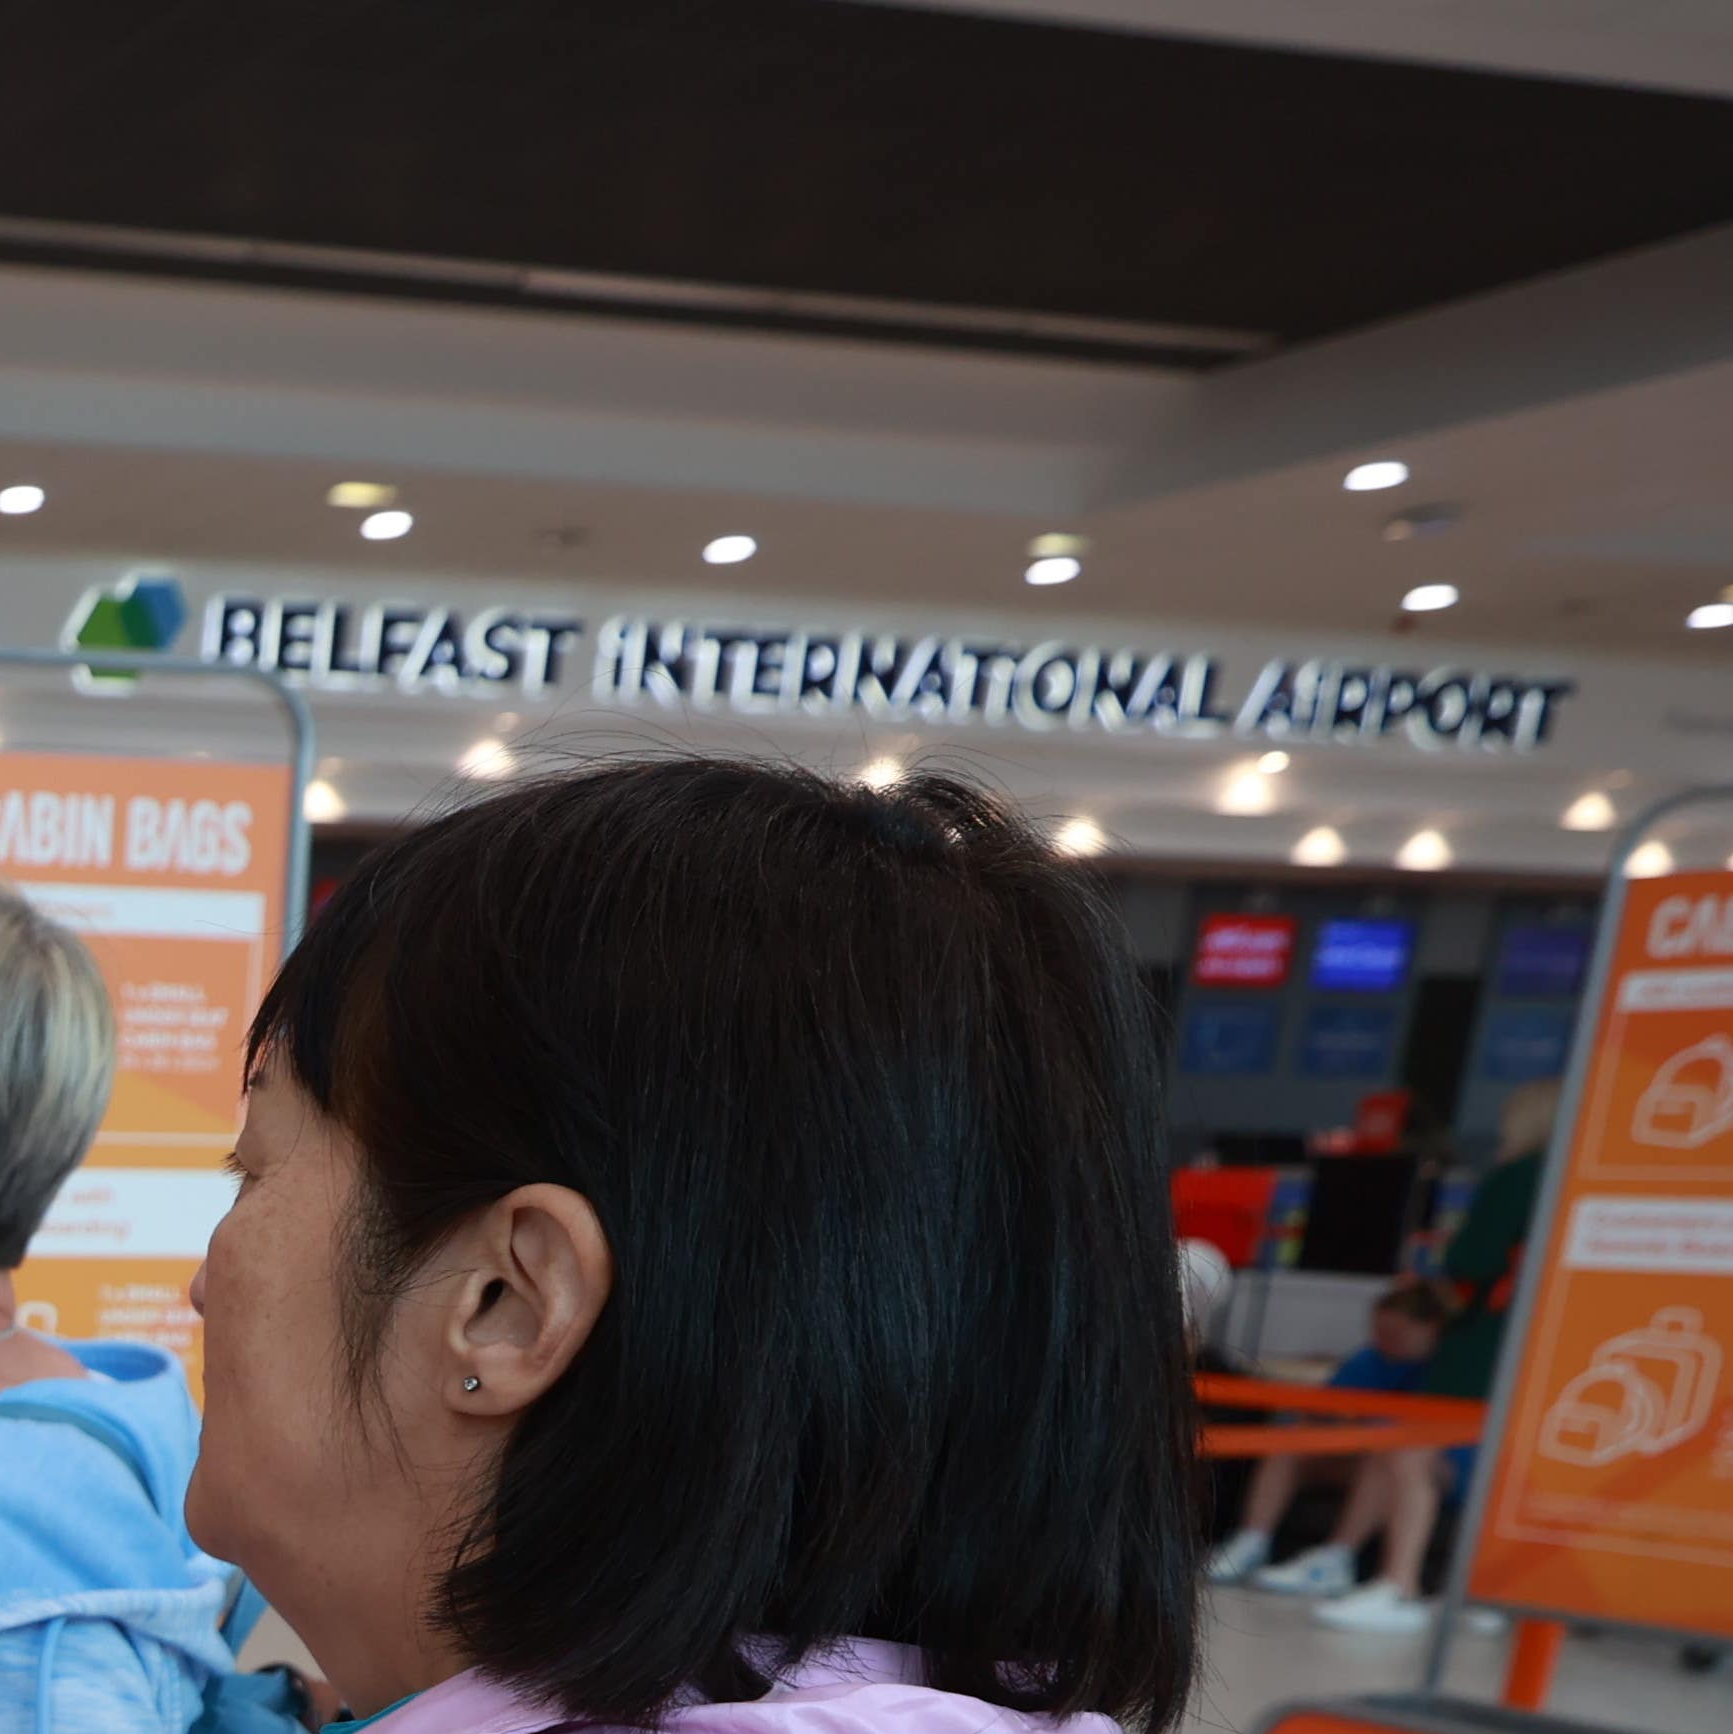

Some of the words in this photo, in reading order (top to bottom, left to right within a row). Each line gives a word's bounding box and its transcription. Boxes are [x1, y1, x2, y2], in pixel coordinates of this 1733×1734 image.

[200, 592, 581, 697] BELFAST
[593, 612, 1231, 738] INTERNATIONAL
[1233, 656, 1579, 754] AIRPORT
[122, 796, 254, 877] BAGS
